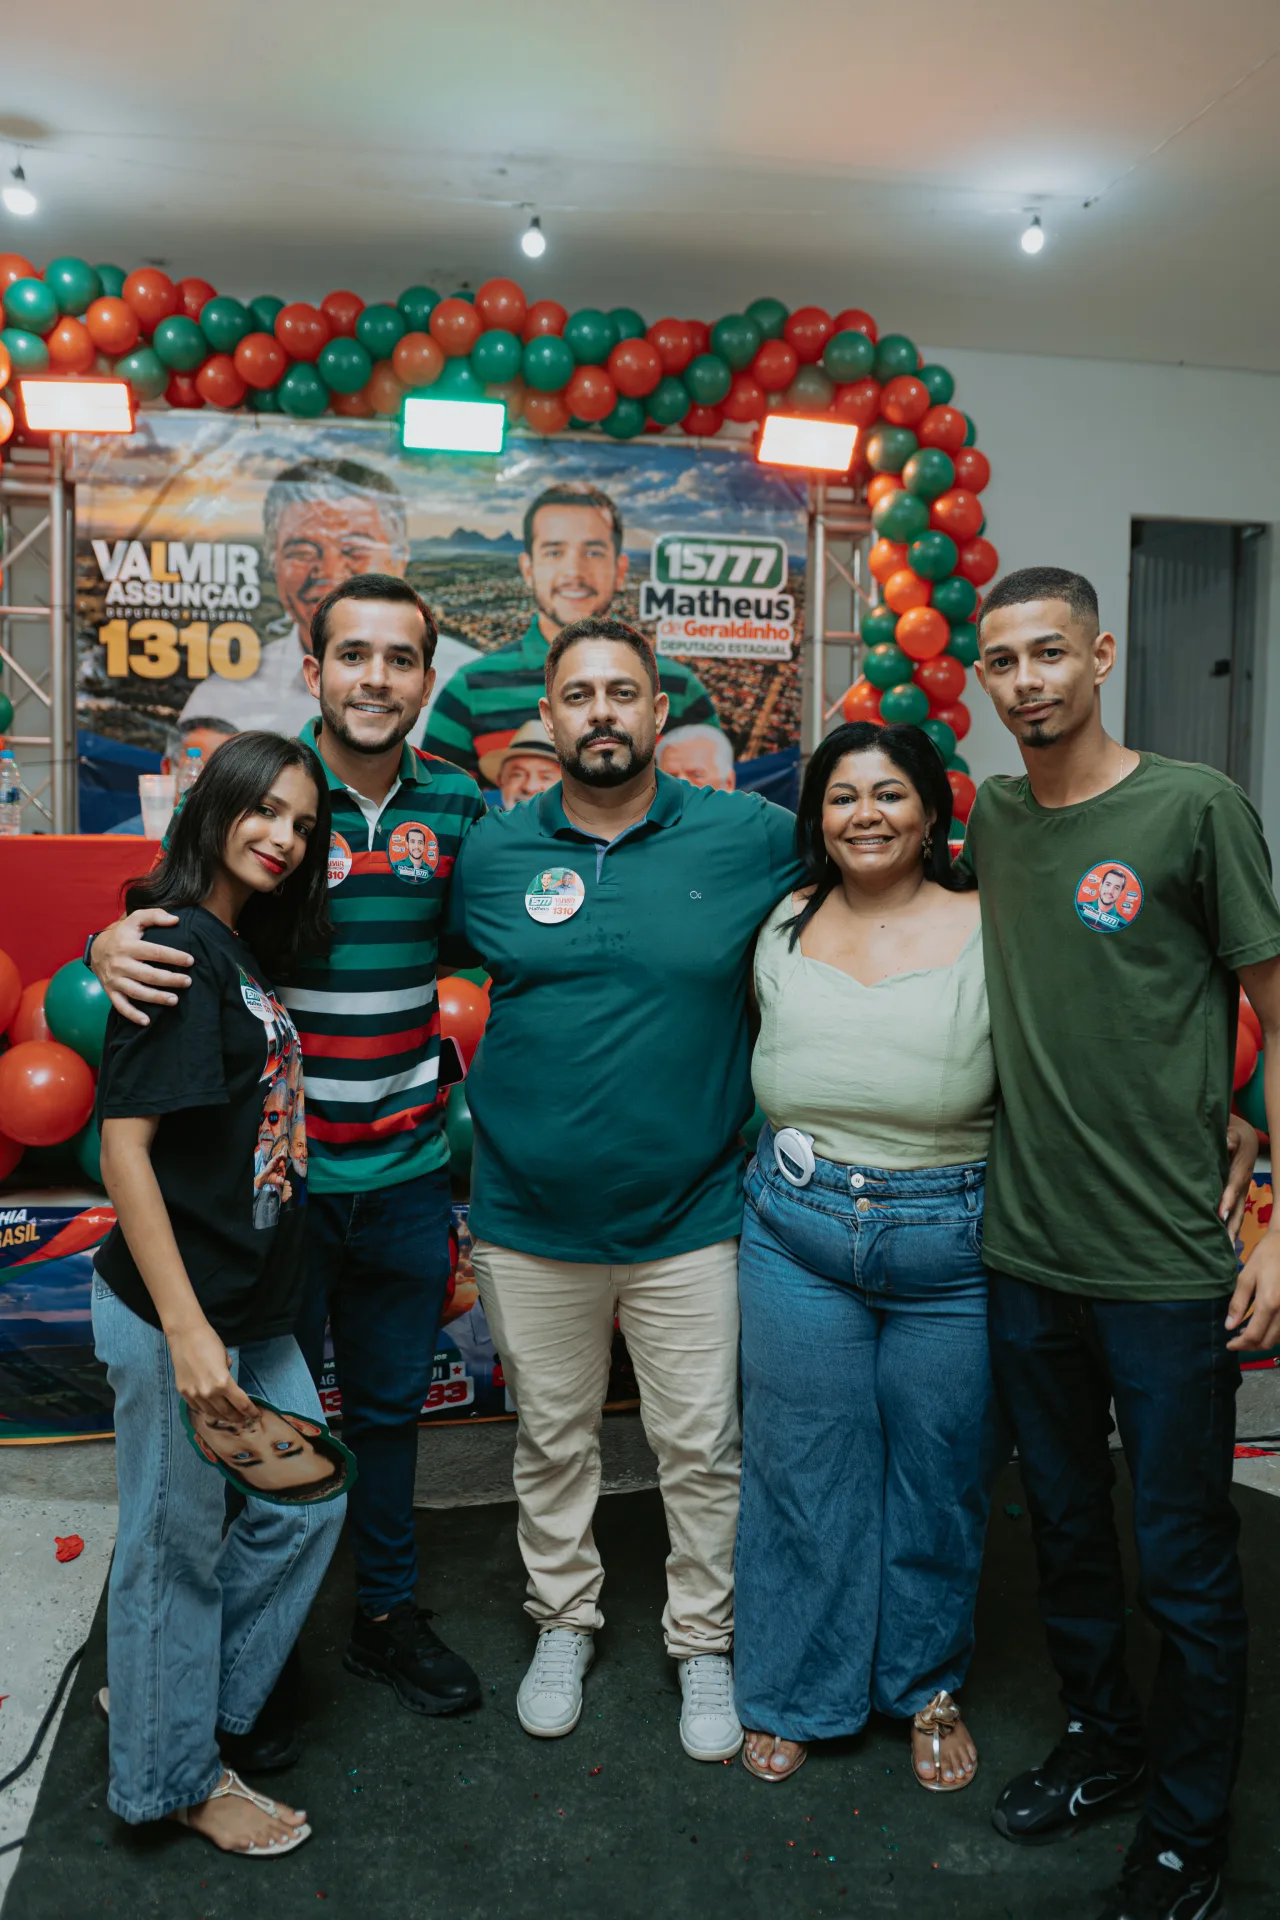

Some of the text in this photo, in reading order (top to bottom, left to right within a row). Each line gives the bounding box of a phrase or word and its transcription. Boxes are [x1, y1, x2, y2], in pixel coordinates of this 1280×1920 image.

[91, 540, 260, 585] VALMIR
[664, 543, 778, 584] 15777
[106, 607, 253, 622] DEPUTADO FEDERAL
[645, 587, 790, 620] Matheus
[684, 619, 790, 640] Geraldinho
[99, 619, 261, 680] 1310
[661, 640, 787, 656] DEPUTADO ESTADUAL
